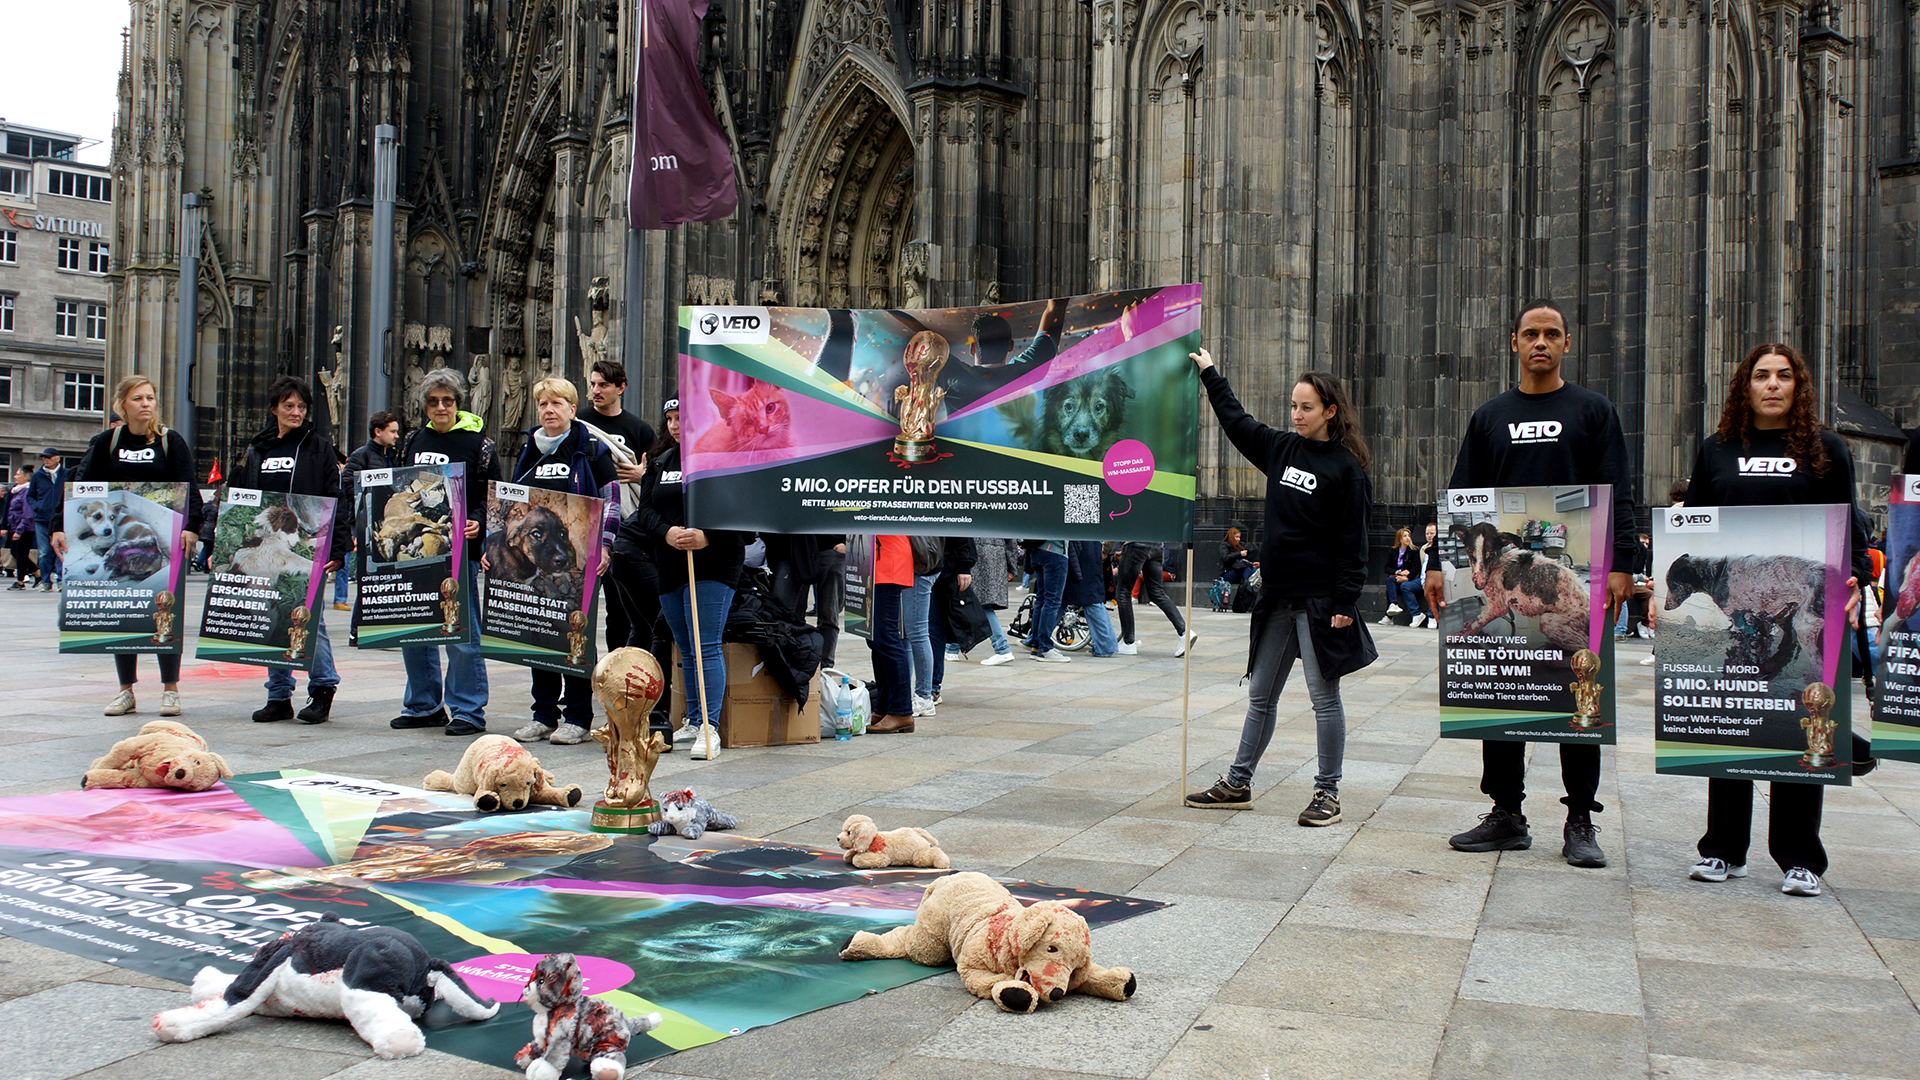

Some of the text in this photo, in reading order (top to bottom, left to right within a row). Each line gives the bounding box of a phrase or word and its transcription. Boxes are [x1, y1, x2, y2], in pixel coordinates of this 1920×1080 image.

[35, 214, 102, 238] SATURN
[722, 315, 761, 330] VETO
[1507, 420, 1562, 439] VETO
[118, 448, 155, 461] VETO
[414, 451, 450, 465] VETO
[261, 456, 295, 470] VETO
[1113, 459, 1131, 468] STOPP
[1737, 457, 1797, 473] VETO
[372, 472, 389, 480] VETO
[535, 463, 571, 477] VETO
[661, 470, 682, 482] VET
[1107, 465, 1151, 476] WM-MASSAKER
[1281, 465, 1317, 490] VETO
[781, 475, 1053, 495] 3 MIO. OPFER FÜR DEN FUSSBALL
[241, 493, 258, 501] VETO
[508, 487, 525, 496] VETO
[801, 499, 1029, 511] RETTE MAROKKOS STRASSENTIERE VOR DER FIFA-WM 2030
[1465, 494, 1489, 504] VETO
[853, 514, 973, 523] veto-tierschutz.de/hundemord-marokko
[1685, 514, 1712, 524] VETO
[214, 572, 271, 587] VERGIFTET.
[489, 578, 535, 592] WIR FORDERN:
[66, 587, 153, 598] MASSENGRÄBER
[211, 584, 282, 600] ERSCHOSSEN.
[361, 582, 413, 594] STOPPT DIE
[209, 597, 268, 611] BEGRABEN.
[361, 592, 439, 606] MASSENTÖTUNG!
[488, 587, 568, 609] TIERHEIME STATT
[65, 600, 151, 609] STATT FAIRPLAY
[488, 598, 567, 621] MASSENGRÄBER!
[65, 612, 90, 620] Fairplay
[207, 610, 235, 619] Marokko
[487, 610, 553, 628] Marokkos Straßenhunde
[206, 618, 249, 628] Straßenhunde
[487, 618, 513, 627] verdienen
[513, 622, 529, 630] Liebe
[540, 627, 560, 637] Schutz
[1446, 635, 1527, 644] FIFA SCHAUT WEG
[1889, 631, 1910, 641] WIR
[1446, 646, 1563, 661] KEINE TÖTUNGEN
[1887, 645, 1920, 660] FIFA
[1446, 661, 1531, 677] FÜR DIE WM!
[1663, 663, 1715, 673] FUSSBALL
[1725, 665, 1760, 674] MORD
[1446, 681, 1563, 691] Für die WM 2030 in Marokko
[1663, 678, 1769, 692] 3 MIO. HUNDE
[1884, 680, 1907, 691] Wer
[1447, 691, 1551, 701] dürfen keine Tiere sterben.
[1883, 694, 1903, 703] und
[1663, 695, 1796, 711] SOLLEN STERBEN
[1882, 705, 1902, 715] sich
[1663, 713, 1764, 725] Unser WM-Fieber darf
[1663, 724, 1750, 736] keine Leben kosten!
[1726, 768, 1836, 779] veto-tierschutz.de/hundemord-marokko
[22, 859, 90, 870] 3
[57, 866, 194, 898] MIO.
[185, 943, 254, 963] FIFA-W
